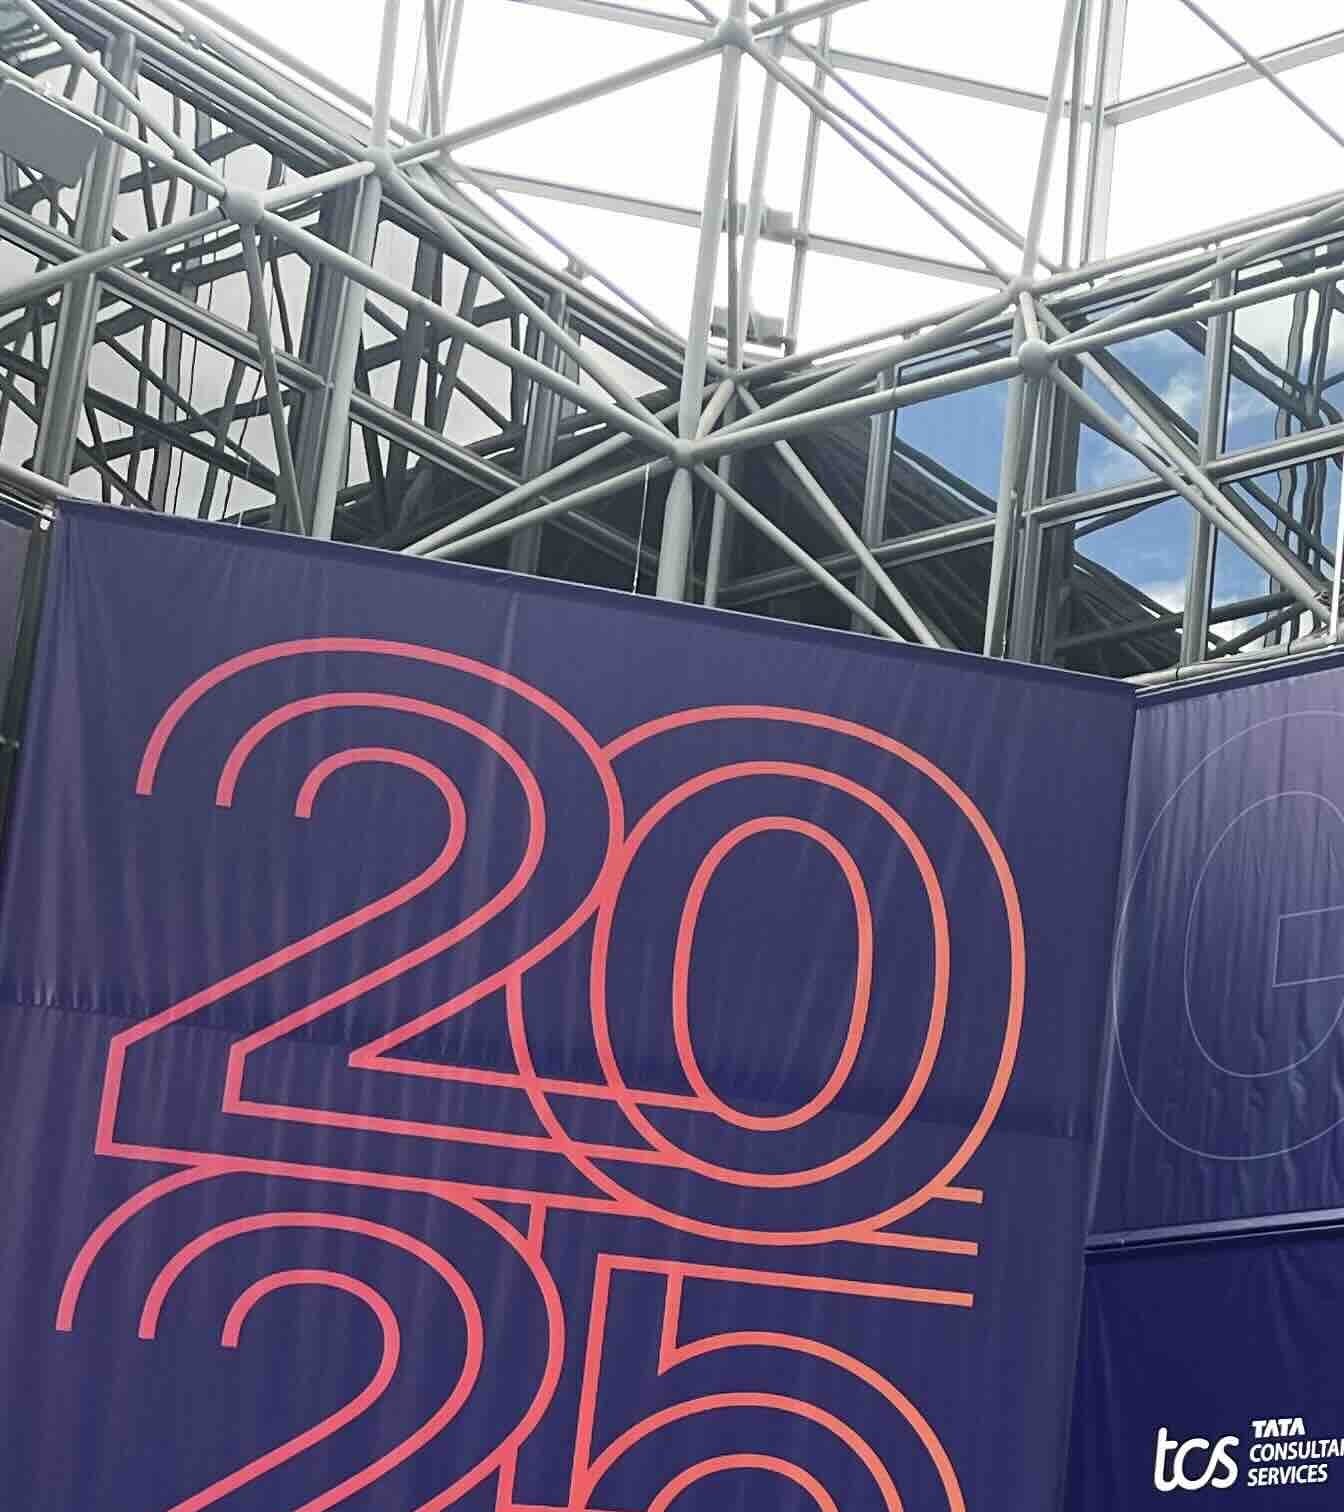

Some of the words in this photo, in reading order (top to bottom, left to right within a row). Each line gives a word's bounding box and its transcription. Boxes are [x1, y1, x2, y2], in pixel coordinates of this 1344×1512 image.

[95, 637, 1025, 1247] 20
[1252, 1417, 1306, 1438] TATA
[1154, 1427, 1240, 1491] tcs
[1247, 1464, 1328, 1487] SERVICES
